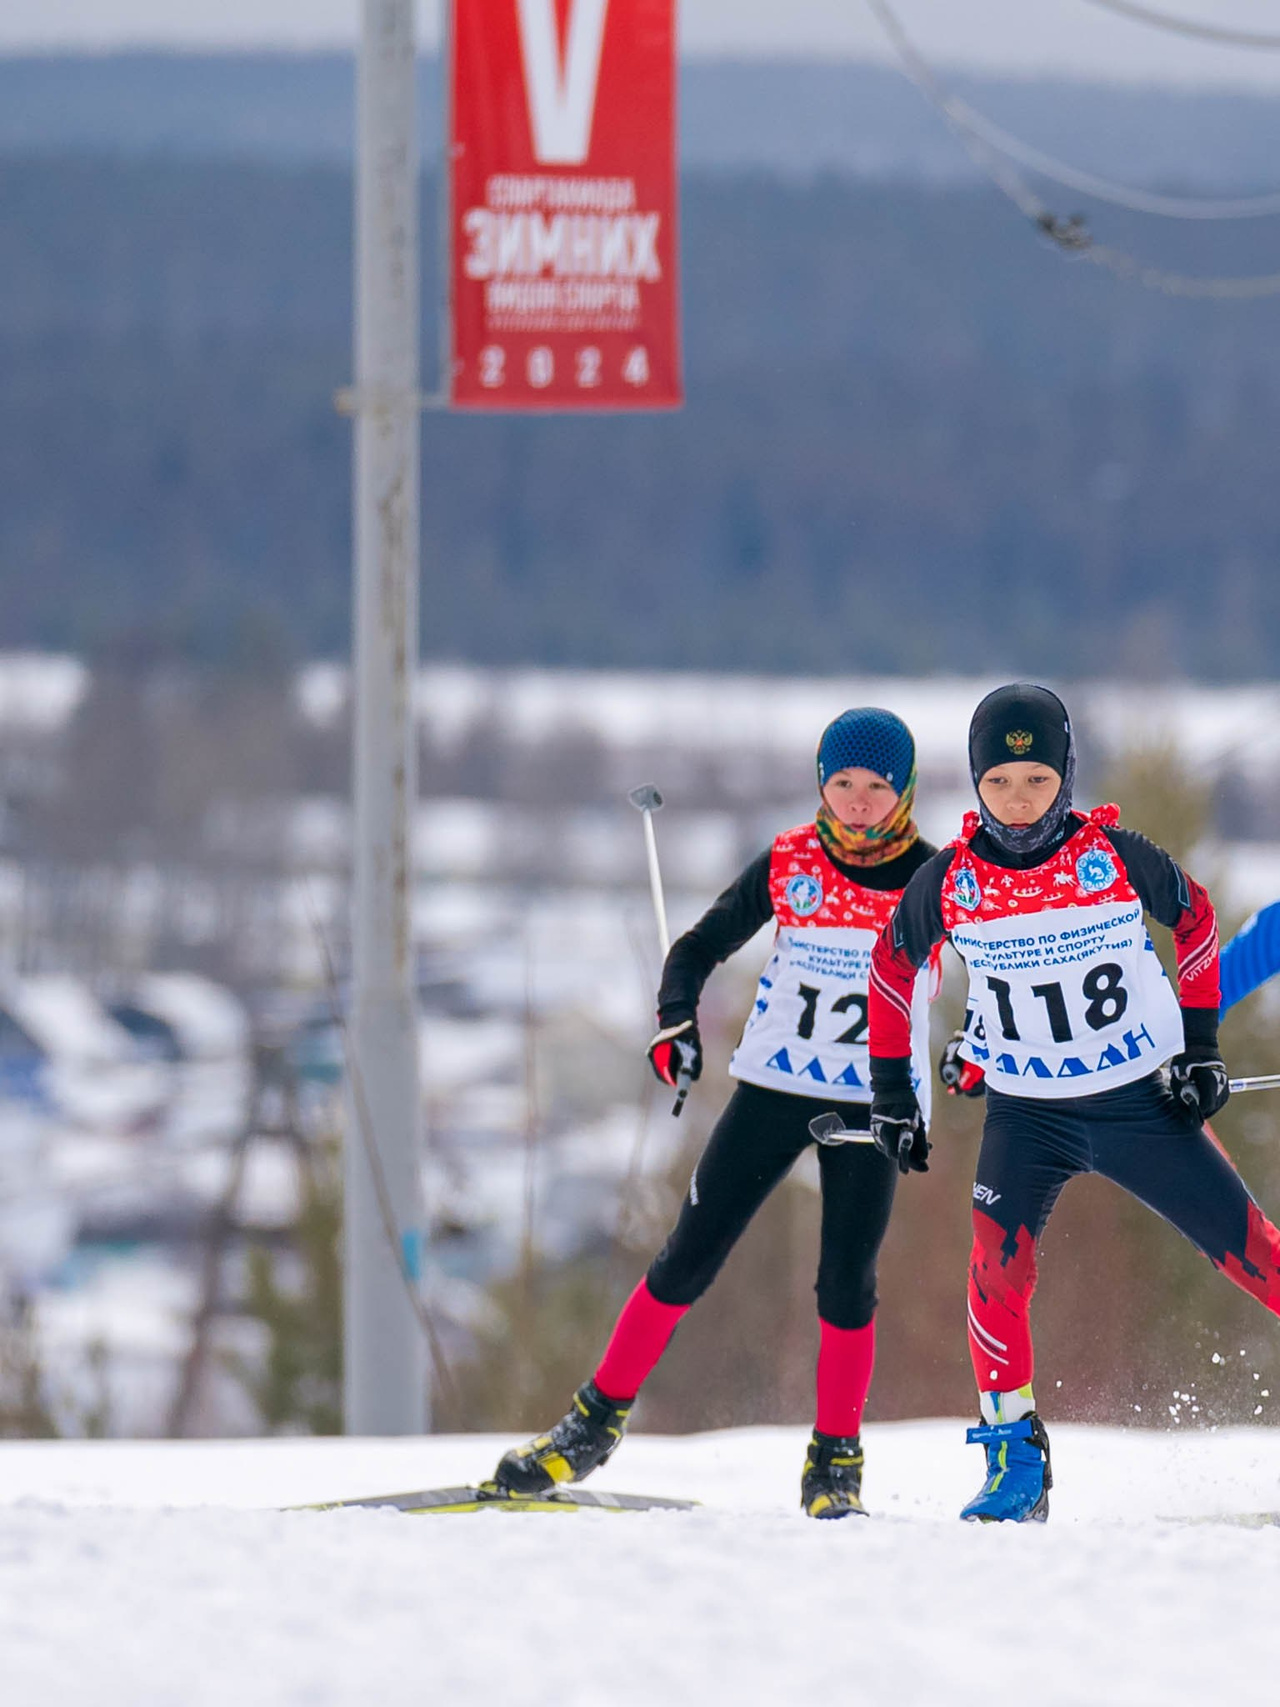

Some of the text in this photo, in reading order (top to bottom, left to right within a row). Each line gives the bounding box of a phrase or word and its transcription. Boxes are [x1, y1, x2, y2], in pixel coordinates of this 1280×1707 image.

[516, 0, 609, 164] V
[465, 208, 661, 282] ЗИМНИХ
[1038, 934, 1057, 945] ПО
[1060, 909, 1140, 941] ФИЗИЧЕСКОЙ
[1045, 946, 1054, 956] И
[1057, 935, 1106, 954] СПОРТУ
[985, 962, 1128, 1044] 118
